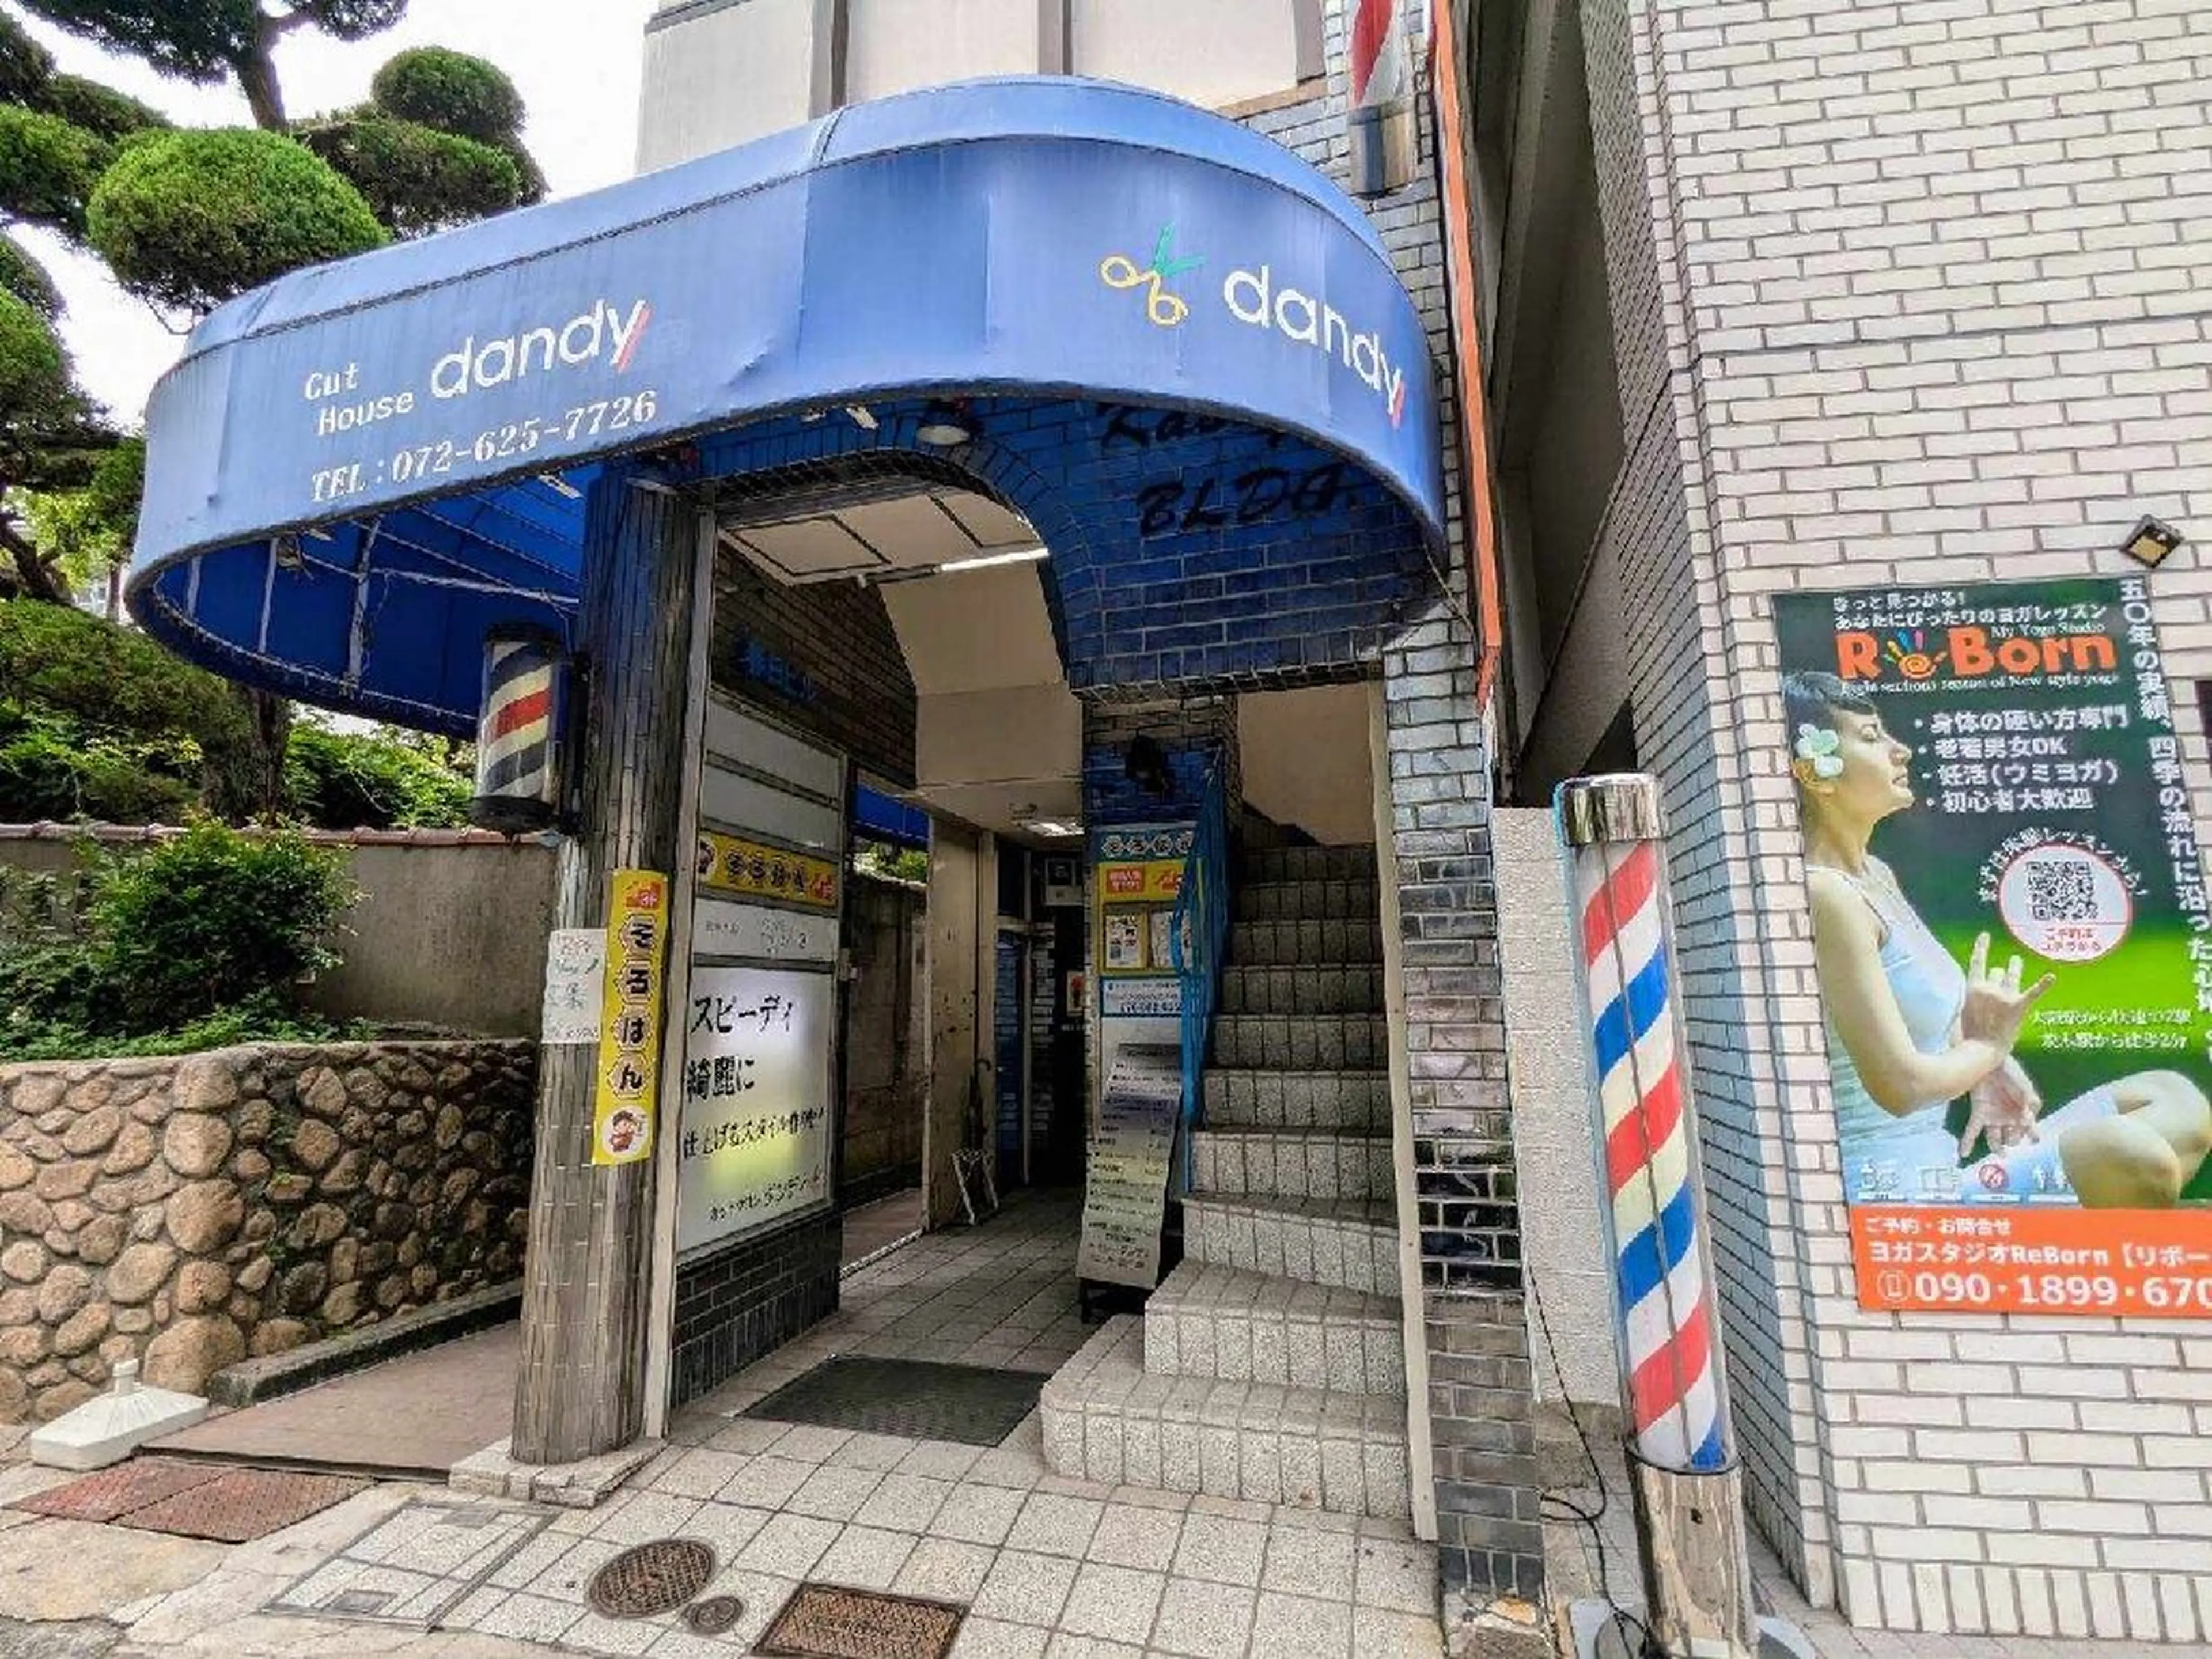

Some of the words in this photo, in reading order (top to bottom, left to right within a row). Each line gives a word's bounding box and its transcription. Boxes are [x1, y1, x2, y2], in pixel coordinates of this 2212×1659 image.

[430, 297, 651, 399] dandy
[1223, 264, 1403, 423] dandy
[304, 362, 359, 401] Cut
[317, 389, 414, 436] House
[2018, 624, 2055, 637] Yoga
[2058, 621, 2106, 634] Studio
[2009, 675, 2042, 687] New
